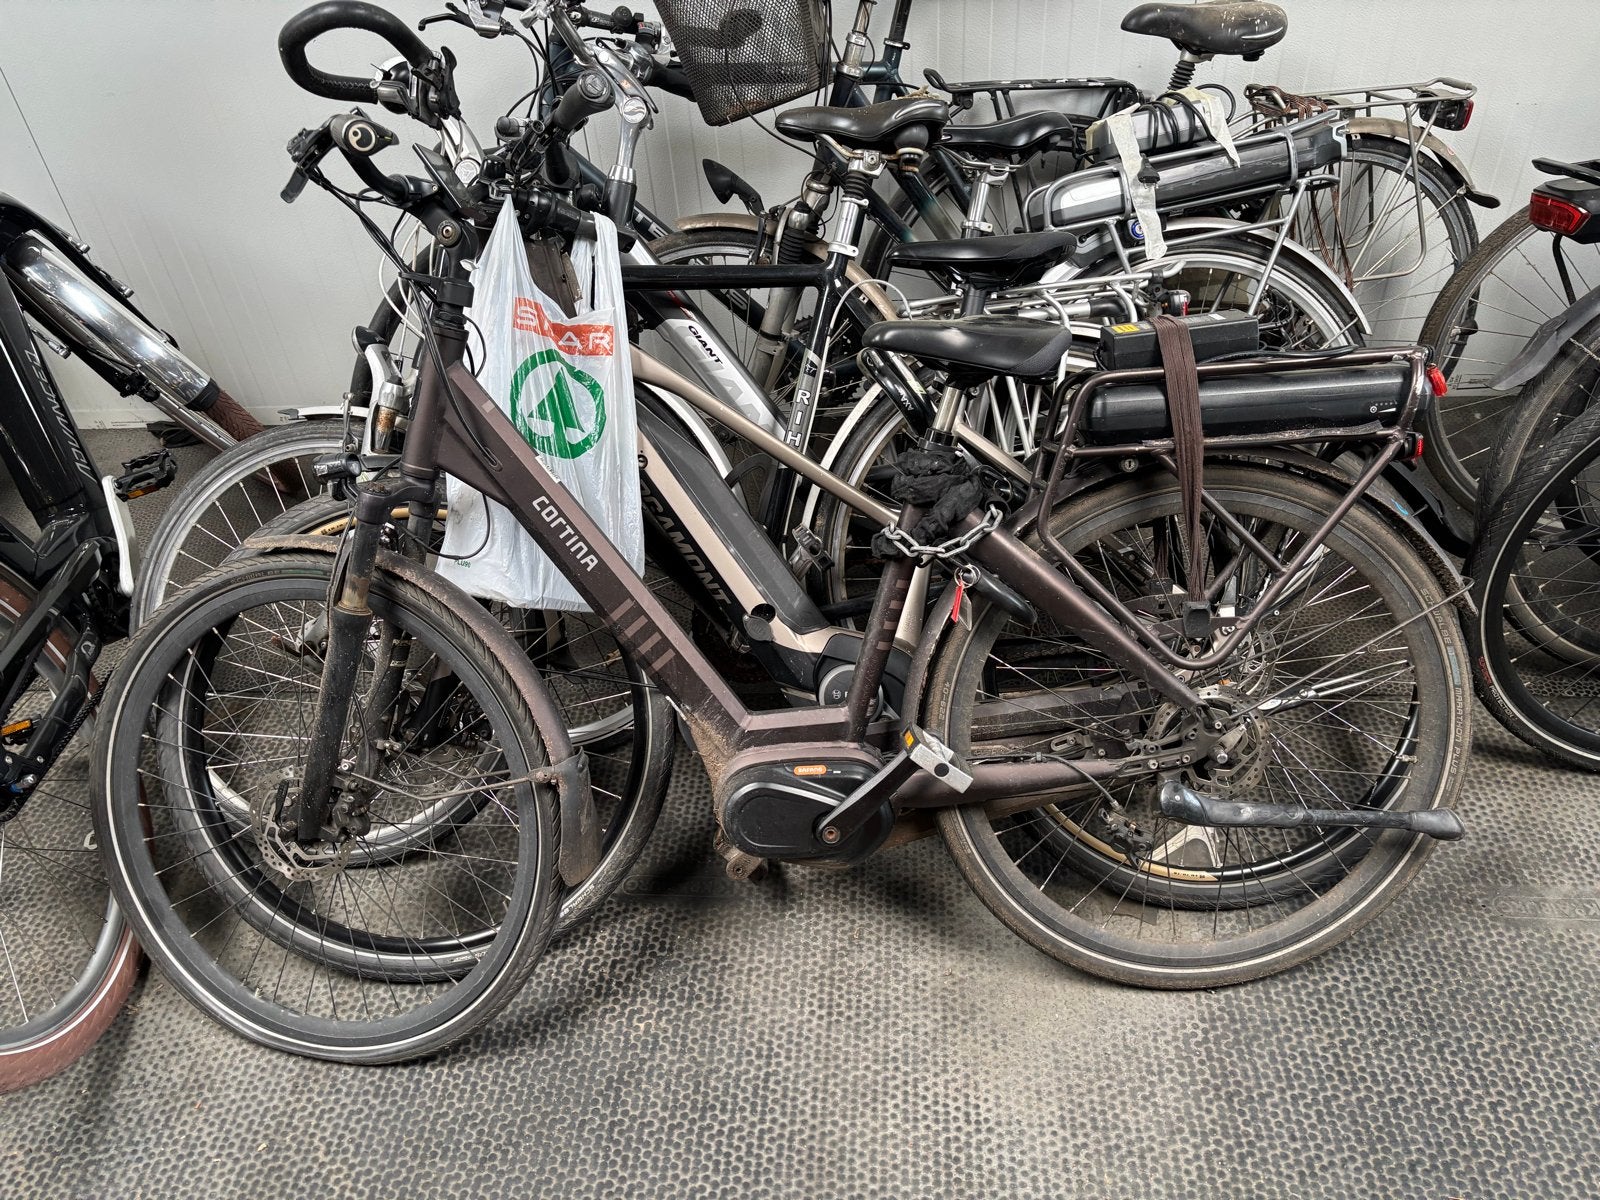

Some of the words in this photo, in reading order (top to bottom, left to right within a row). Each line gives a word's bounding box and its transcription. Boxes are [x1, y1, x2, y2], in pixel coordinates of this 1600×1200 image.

[516, 304, 613, 354] SAR
[688, 325, 723, 364] GIANT
[786, 389, 811, 447] RIH
[532, 495, 599, 572] CORTINA
[1454, 687, 1464, 742] MARATHON
[1450, 747, 1461, 775] PLUS
